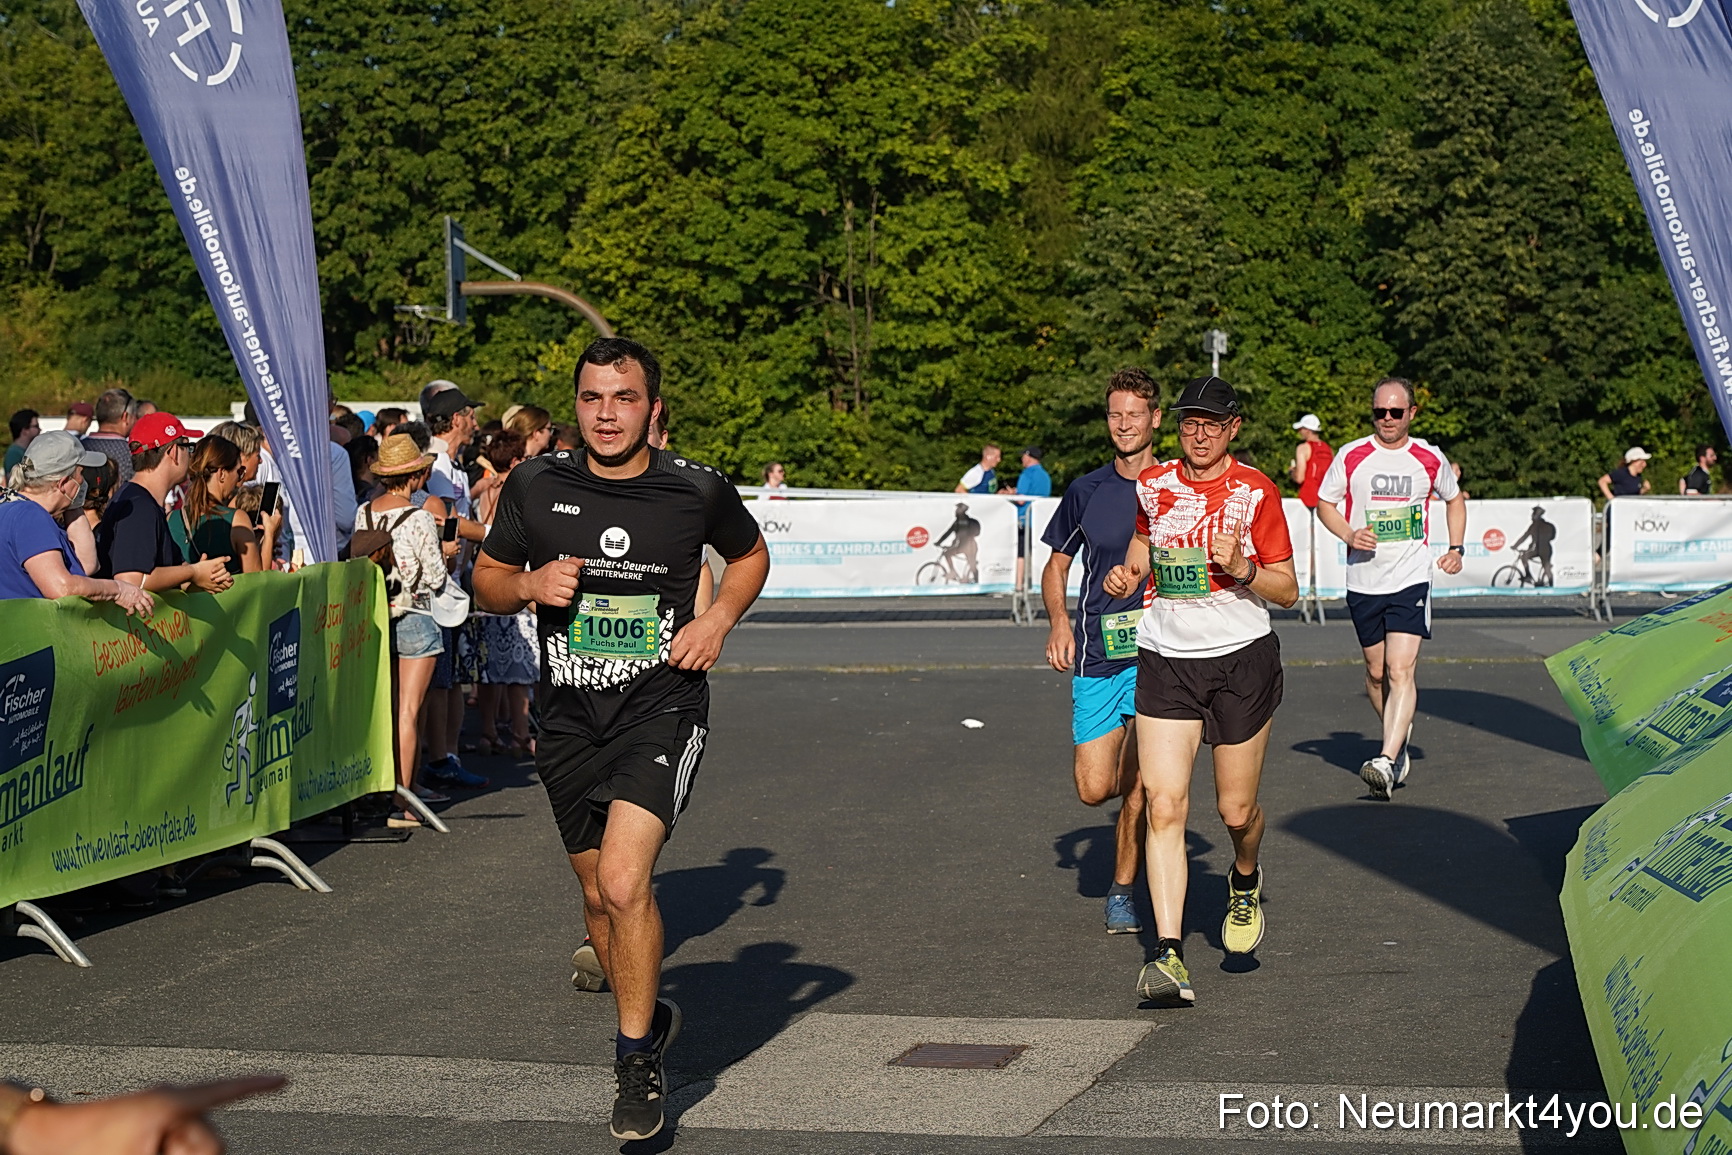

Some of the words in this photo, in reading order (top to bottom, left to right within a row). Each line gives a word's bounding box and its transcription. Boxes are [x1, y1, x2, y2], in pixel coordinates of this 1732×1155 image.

[552, 502, 581, 516] JAKO
[1378, 519, 1402, 532] 500
[1634, 520, 1670, 533] NOW
[581, 568, 643, 581] SCHOTTERWERKE
[1157, 564, 1197, 582] 1105
[1197, 567, 1207, 591] 2022
[573, 620, 582, 643] RUN
[584, 615, 644, 639] 1006
[646, 620, 655, 650] 2022
[92, 618, 148, 677] Gesunde
[590, 638, 616, 648] Fuchs
[617, 640, 637, 649] Paul
[4, 687, 47, 716] Fischer
[8, 705, 40, 726] AUTOMOBILE
[51, 804, 198, 874] www.firmenlauf-oberpfalz.de
